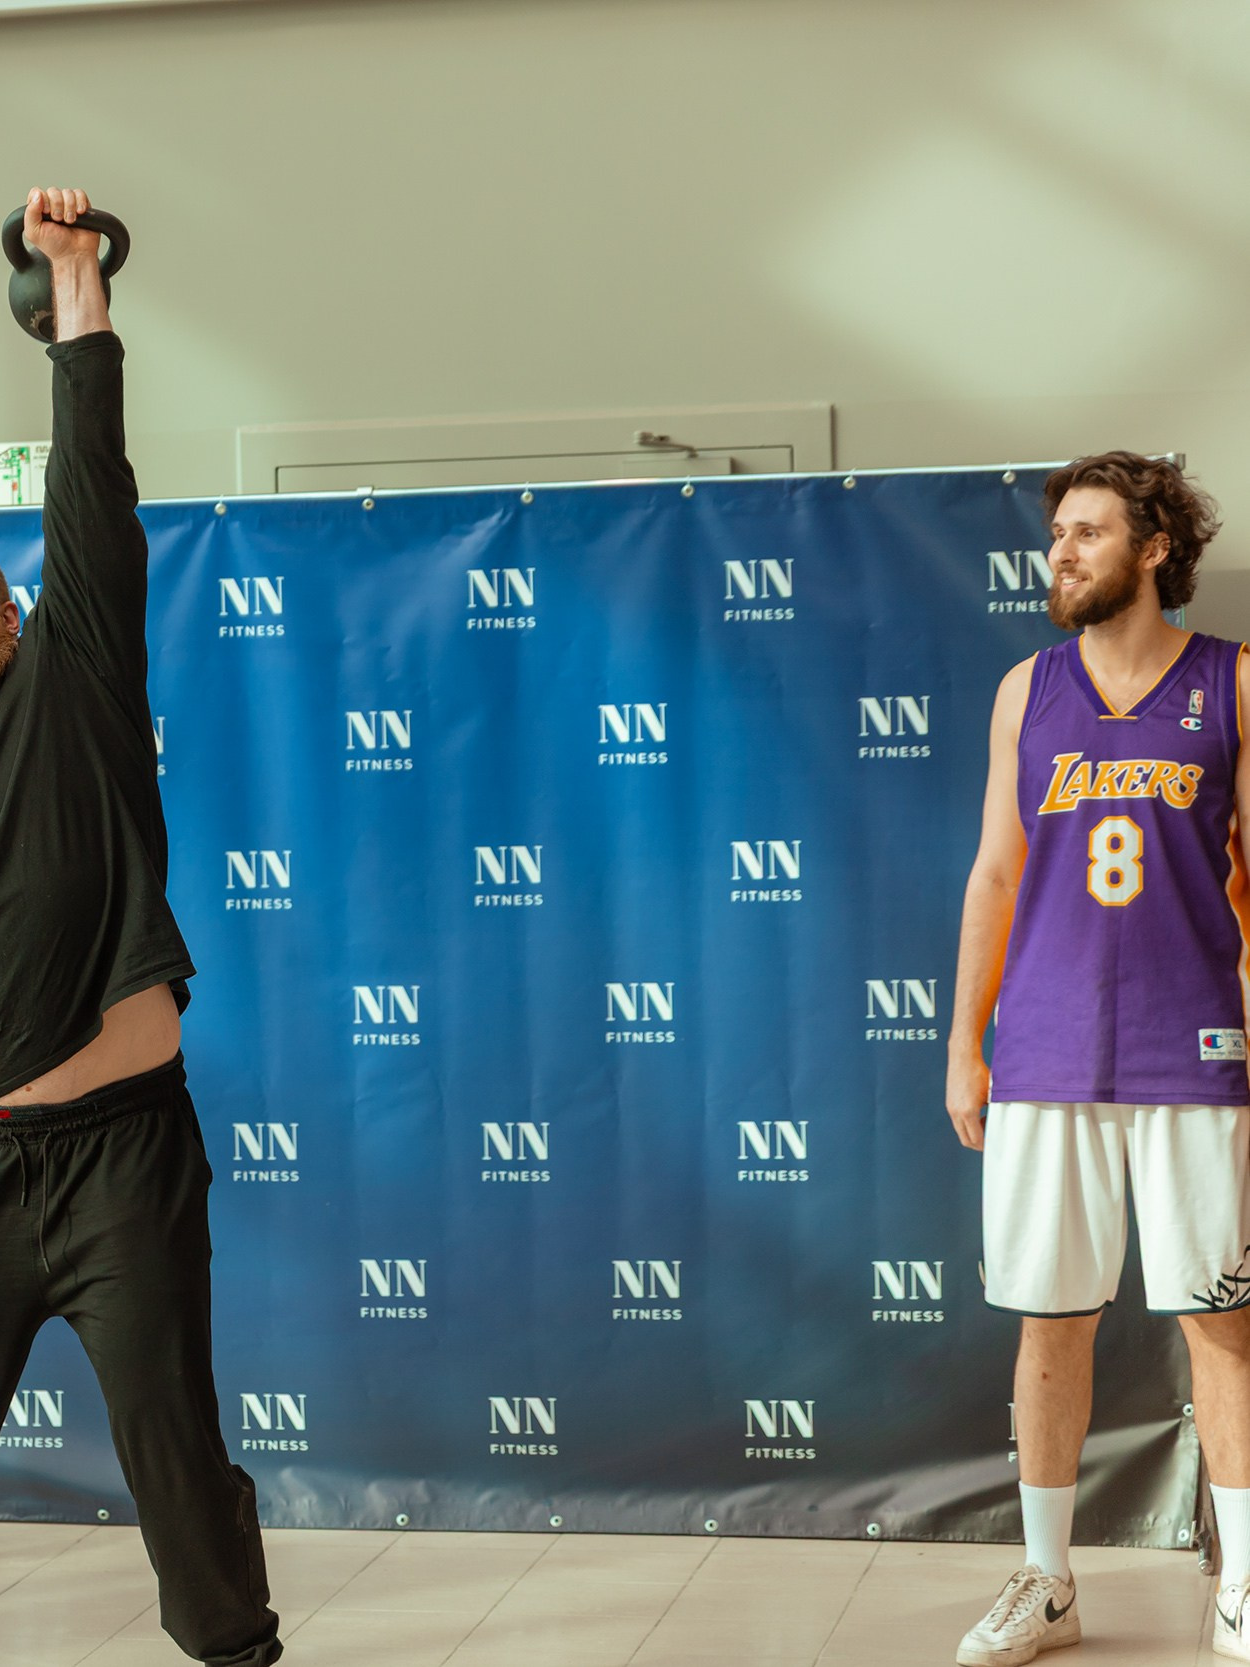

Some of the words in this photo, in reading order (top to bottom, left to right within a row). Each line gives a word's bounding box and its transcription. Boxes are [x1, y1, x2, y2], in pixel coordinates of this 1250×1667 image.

[219, 576, 284, 616] NN
[466, 567, 536, 608] NN
[724, 558, 794, 600] NN
[466, 616, 537, 630] FITNESS
[723, 607, 795, 622] FITNESS
[988, 600, 1049, 613] FITNES
[219, 624, 285, 638] FITNESS
[345, 709, 412, 750] NN
[598, 702, 667, 744] NN
[858, 695, 930, 737] NN
[345, 758, 413, 771] FITNESS
[598, 751, 669, 765] FITNESS
[858, 745, 931, 759] FITNESS
[1037, 752, 1204, 815] LAKERS
[225, 850, 292, 889] NN
[475, 845, 543, 885] NN
[731, 840, 801, 881] NN
[1087, 815, 1143, 906] 8
[225, 897, 293, 910] FITNESS
[474, 893, 544, 907] FITNESS
[730, 889, 803, 902] FITNESS
[352, 985, 420, 1024] NN
[605, 982, 675, 1022] NN
[865, 978, 937, 1019] NN
[352, 1033, 421, 1046] FITNESS
[605, 1030, 676, 1043] FITNESS
[865, 1028, 938, 1041] FITNESS
[232, 1122, 299, 1161] NN
[481, 1122, 550, 1161] NN
[737, 1120, 809, 1160] NN
[232, 1170, 300, 1183] FITNESS
[481, 1170, 551, 1183] FITNESS
[737, 1169, 810, 1182] FITNESS
[359, 1259, 427, 1298] NN
[612, 1260, 682, 1299] NN
[871, 1260, 944, 1300] NN
[360, 1306, 428, 1319] FITNESS
[612, 1308, 683, 1321] FITNESS
[872, 1310, 945, 1323] FITNESS
[240, 1393, 307, 1431] NN
[488, 1396, 557, 1435] NN
[744, 1399, 815, 1438] NN
[242, 1439, 309, 1452] FITNESS
[489, 1443, 559, 1456] FITNESS
[745, 1447, 817, 1460] FITNESS
